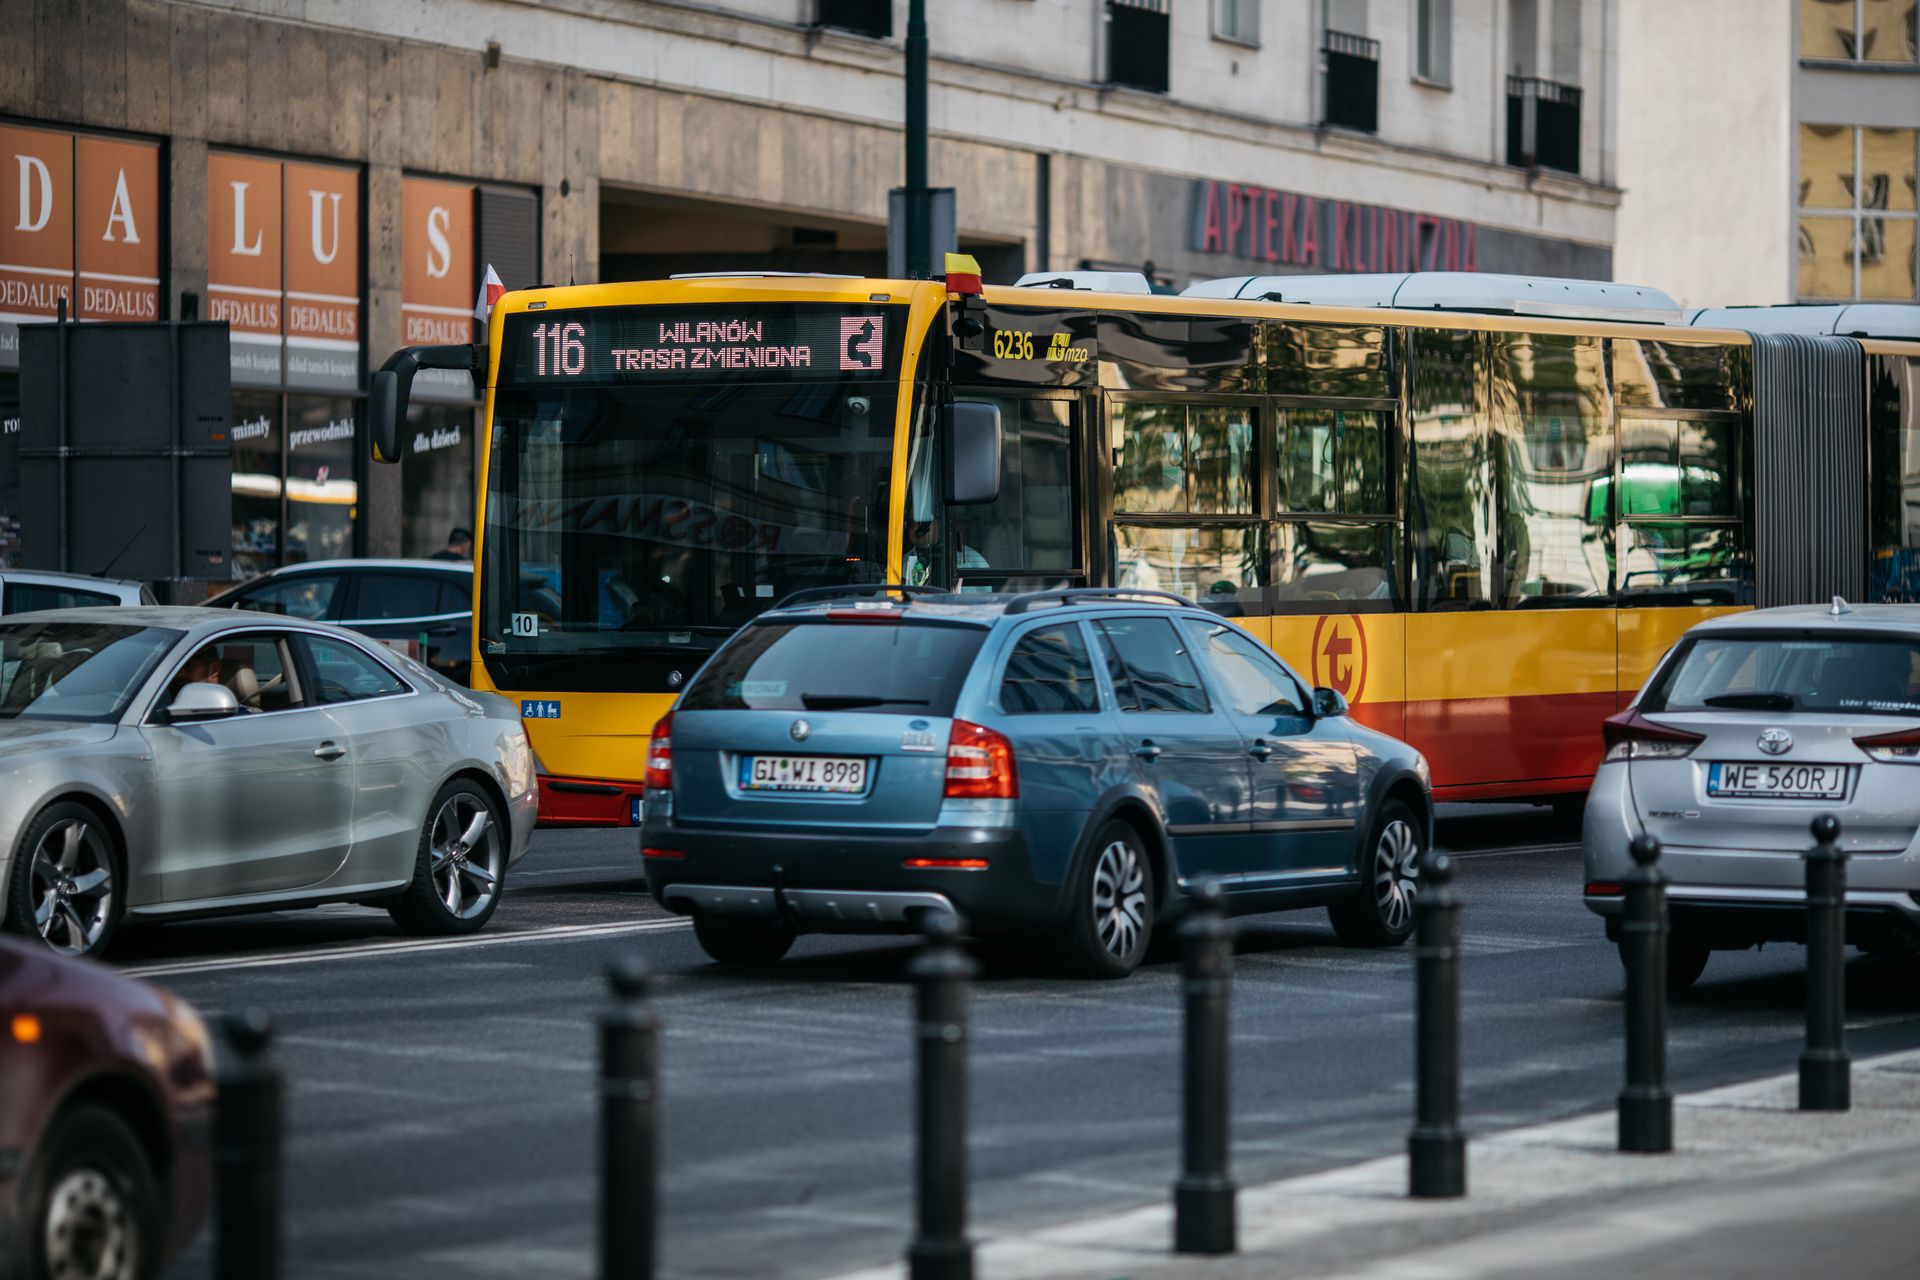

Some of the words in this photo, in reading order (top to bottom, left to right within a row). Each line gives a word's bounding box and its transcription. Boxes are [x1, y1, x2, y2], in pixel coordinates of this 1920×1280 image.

[1203, 180, 1318, 267] APTEKA
[1335, 200, 1478, 272] KLINICZNA
[84, 287, 155, 317] DEDALUS
[211, 299, 278, 328] DEDALUS
[290, 305, 355, 336] DEDALUS
[406, 317, 470, 344] DEDALUS
[660, 319, 762, 343] WILANÓW
[533, 323, 585, 376] 116
[611, 349, 686, 369] TRASA
[691, 346, 811, 369] ZMIENIONA
[994, 330, 1034, 360] 6236
[290, 418, 355, 451] przewodniki
[516, 616, 532, 633] 10
[755, 759, 777, 782] GI
[792, 761, 816, 782] WI
[822, 762, 861, 783] 898
[1725, 765, 1759, 789] WE
[1767, 766, 1840, 791] 560RJ
